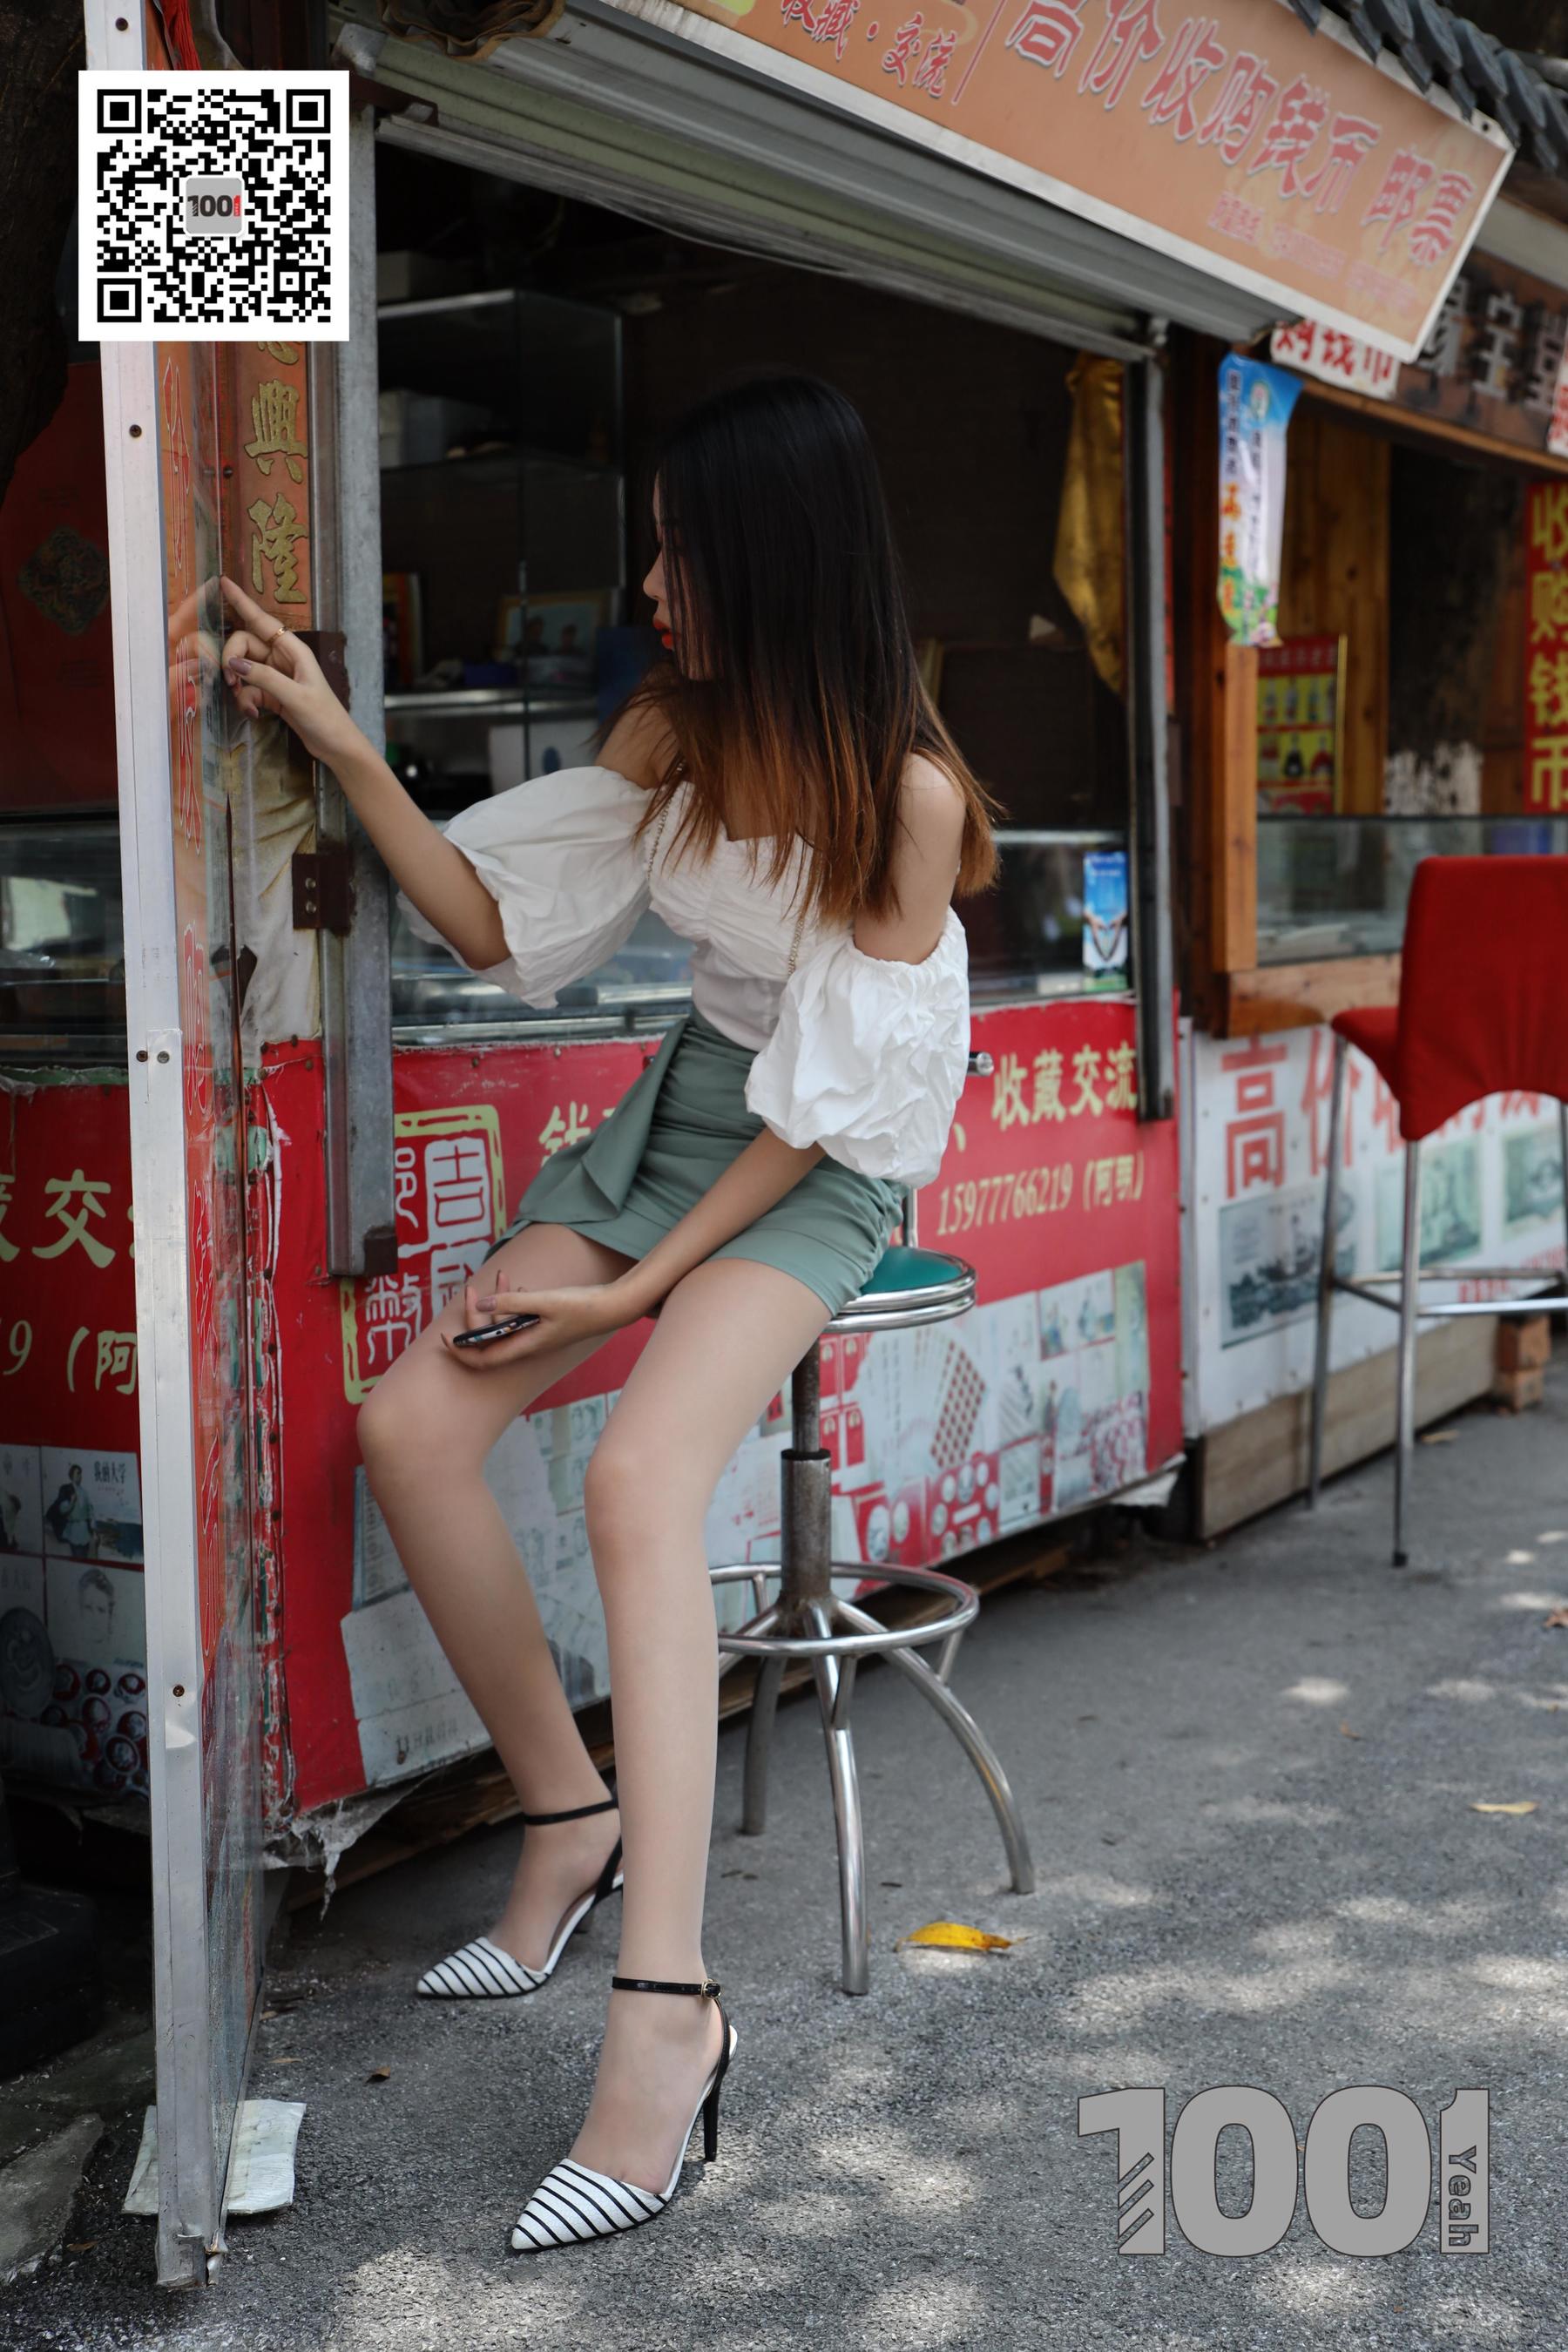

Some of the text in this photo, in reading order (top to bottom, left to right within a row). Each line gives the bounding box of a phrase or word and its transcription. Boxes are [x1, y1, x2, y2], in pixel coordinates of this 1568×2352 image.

[1361, 145, 1475, 269] 邮票
[244, 341, 308, 604] 興隆
[991, 1040, 1138, 1132] 收藏交流
[937, 1162, 1073, 1236] 15977766219
